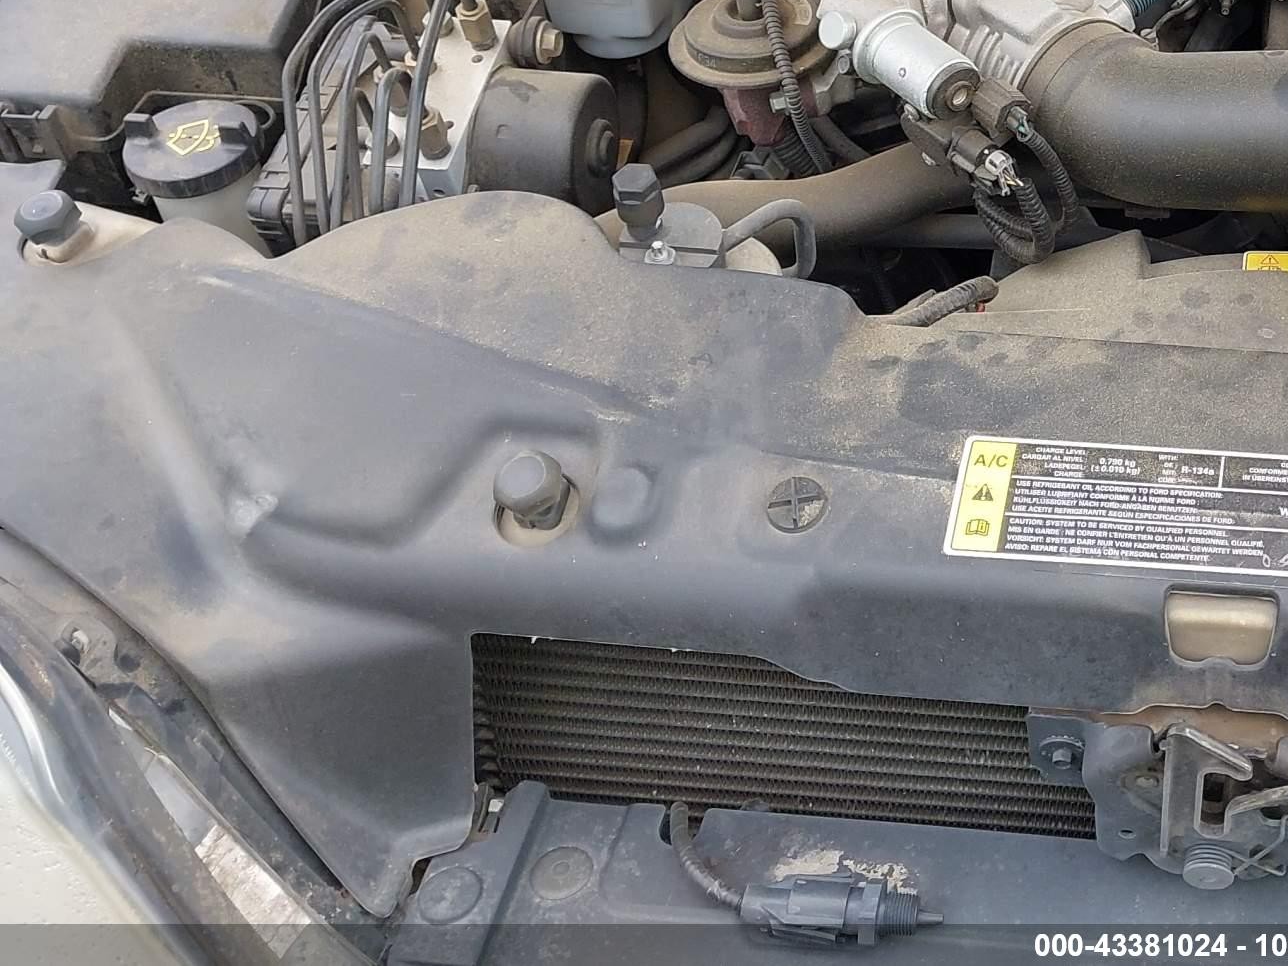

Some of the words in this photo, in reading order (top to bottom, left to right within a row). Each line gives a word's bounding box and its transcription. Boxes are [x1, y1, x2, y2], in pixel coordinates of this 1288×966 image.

[973, 453, 1008, 468] A/C
[1181, 466, 1214, 475] R-134a
[1249, 466, 1288, 475] CONFORME
[1015, 479, 1031, 487] USE
[1094, 484, 1136, 493] ACCORDING
[1149, 487, 1168, 495] FORD
[1170, 489, 1223, 498] SPECIFICATION:
[1089, 492, 1129, 501] CONFORME
[1148, 496, 1175, 504] NORME
[1176, 497, 1195, 505] FORD
[1027, 505, 1052, 513] ACEITE
[1009, 517, 1044, 525] CAUTION:
[1045, 519, 1075, 527] SYSTEM
[1098, 522, 1133, 531] SERVICED
[1145, 525, 1183, 534] QUALIFIED
[1034, 527, 1060, 535] GARDE
[1076, 529, 1107, 537] CONFIER
[1186, 536, 1229, 545] PERSONNEL
[1006, 534, 1044, 542] VORSICHT:
[1045, 536, 1075, 544] SYSTEM
[1133, 541, 1189, 551] FACHPERSONAL
[1190, 545, 1230, 554] GEWARTET
[1030, 544, 1057, 552] REPARE
[1069, 546, 1101, 555] SISTEMA
[1120, 549, 1159, 558] PERSONAL
